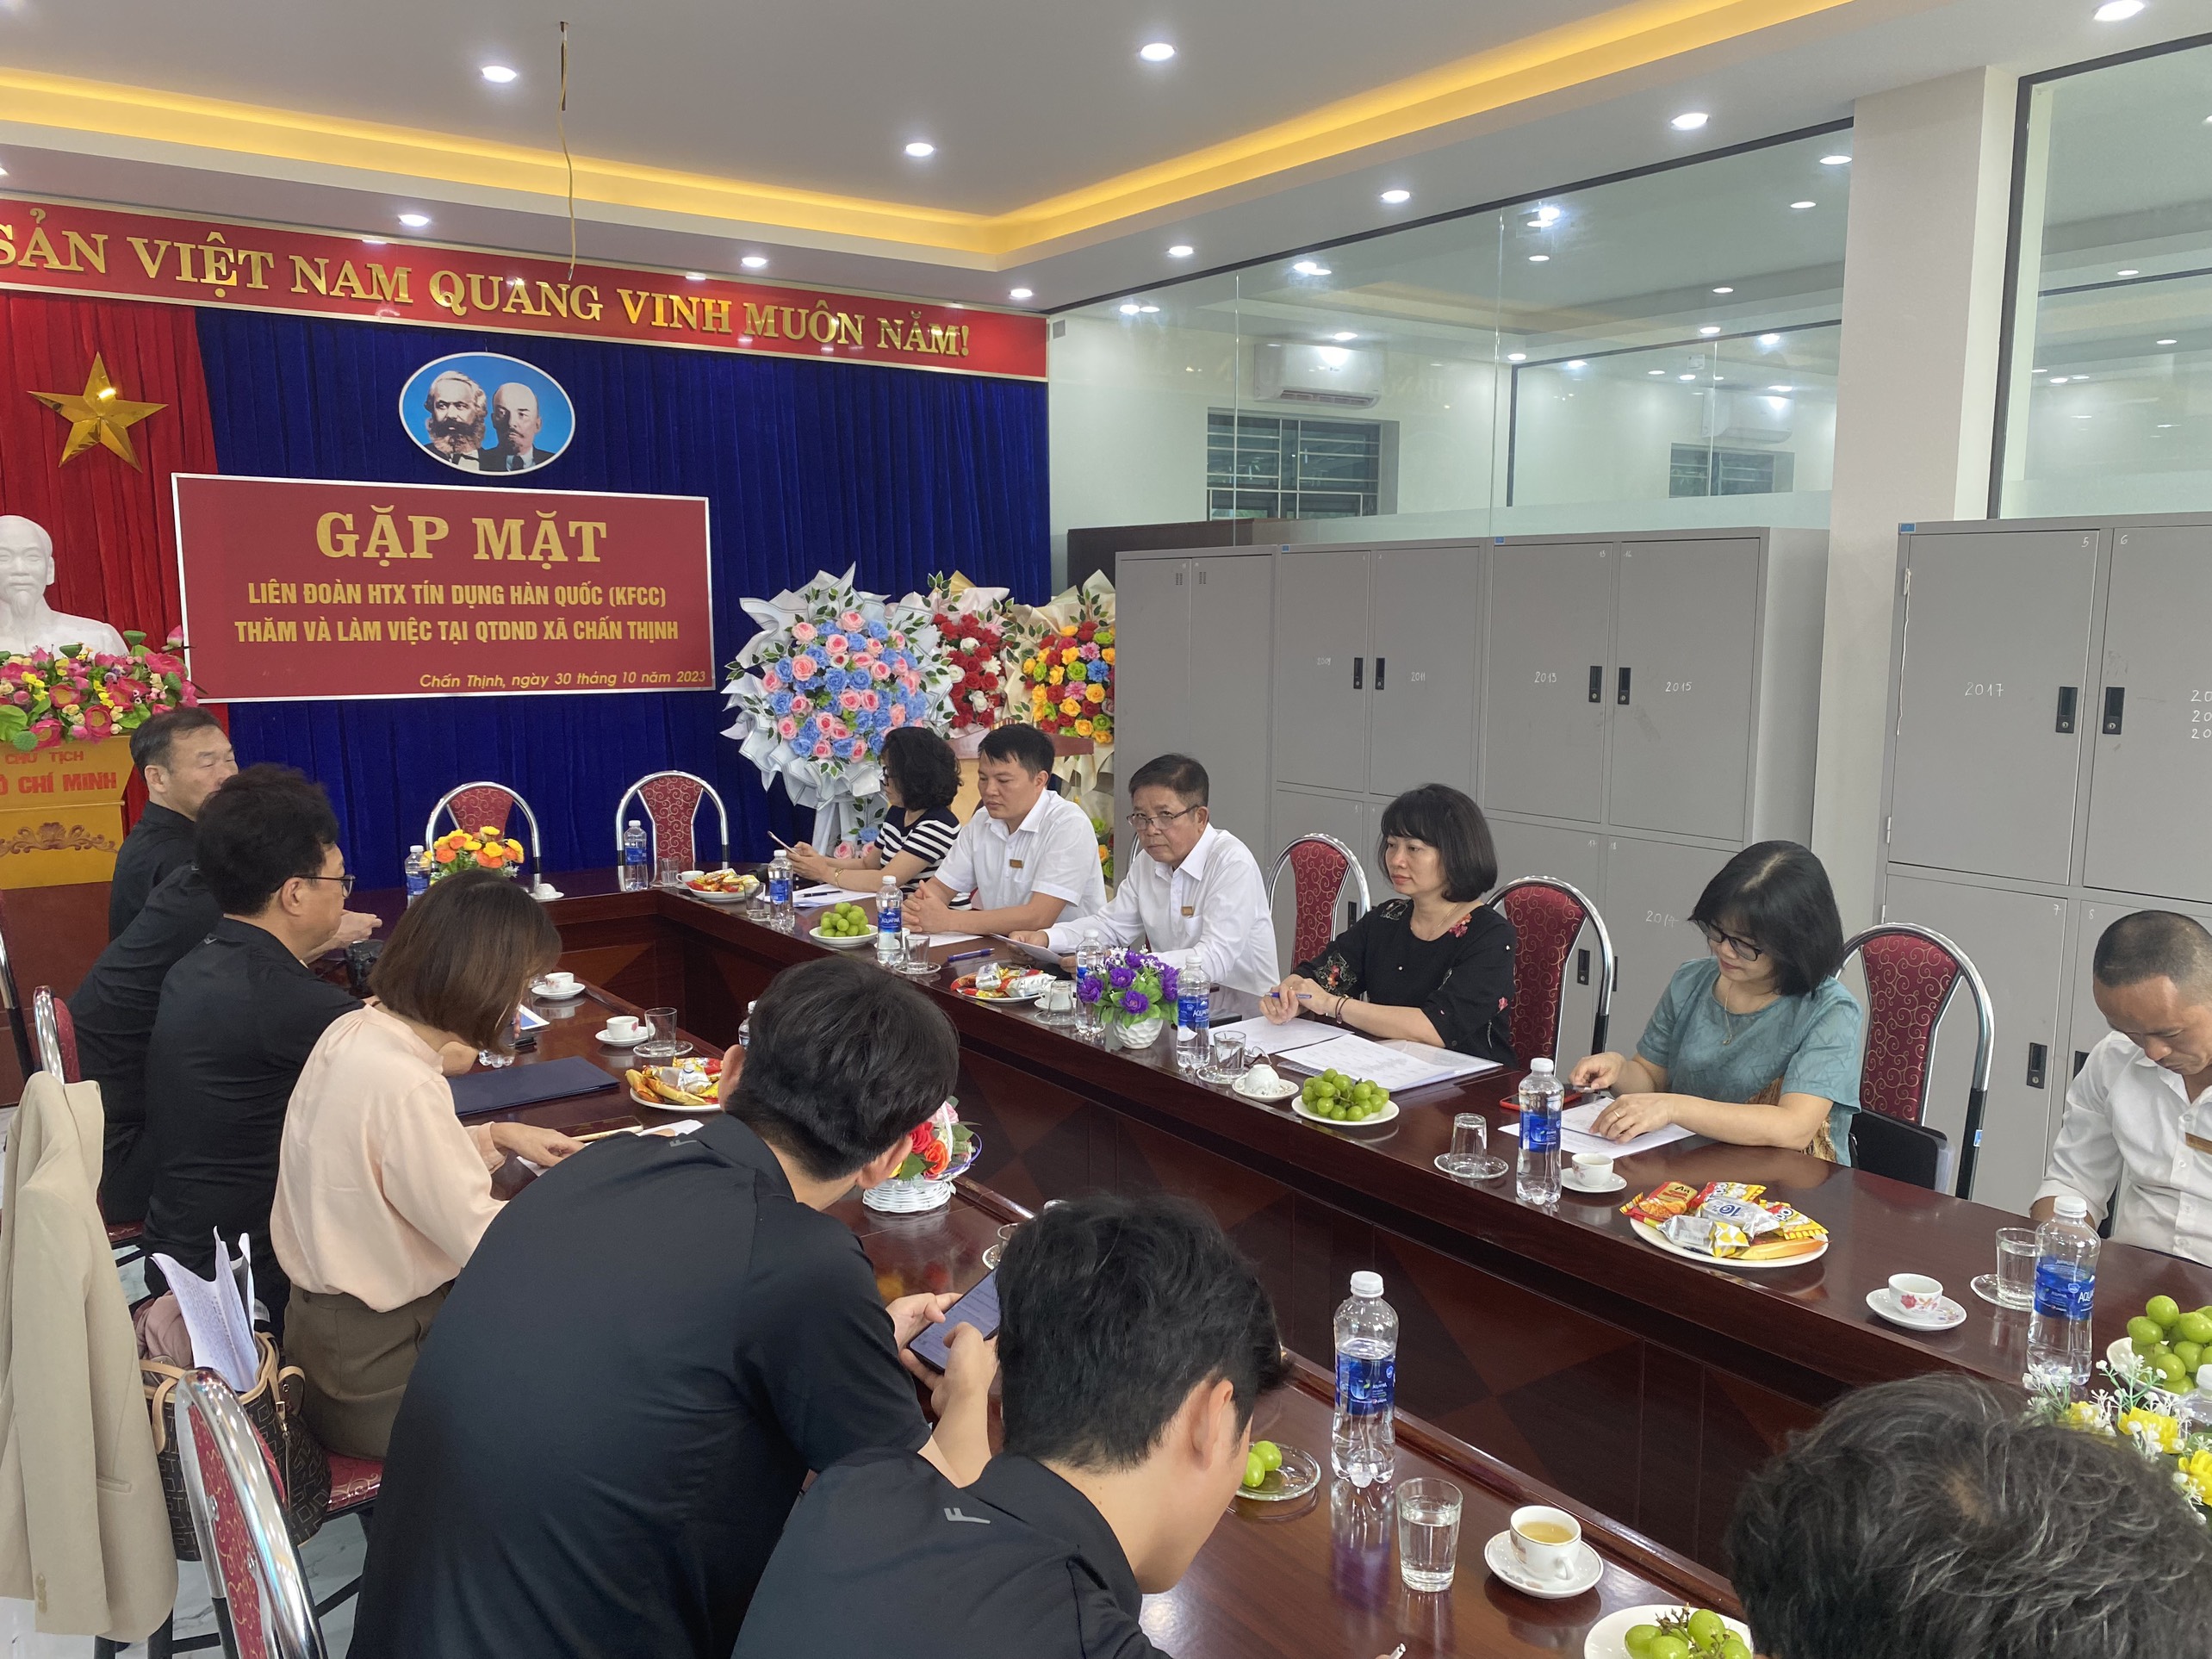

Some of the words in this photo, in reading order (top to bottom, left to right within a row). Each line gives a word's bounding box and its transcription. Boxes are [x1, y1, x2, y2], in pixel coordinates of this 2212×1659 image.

[0, 208, 109, 274] SẢN
[126, 231, 275, 298] VIỆT
[289, 255, 414, 304] NAM
[430, 269, 601, 321] QUANG
[617, 289, 732, 333] VINH
[743, 300, 864, 346] MUÔN
[877, 310, 970, 357] NĂM!
[316, 505, 450, 567] GẶP
[472, 510, 607, 570] MẶT
[2081, 537, 2090, 548] 5
[2120, 534, 2128, 545] 6
[248, 579, 297, 604] LIÊN
[303, 579, 362, 605] ĐOÀN
[368, 584, 407, 605] HTX
[412, 580, 444, 605] TÍN
[451, 585, 505, 609] DỤNG
[510, 581, 549, 605] HÀN
[555, 581, 603, 606] QUỐC
[609, 587, 666, 607] (KFCC)
[234, 617, 297, 643] THĂM
[303, 616, 332, 642] VÀ
[337, 617, 382, 642] LÀM
[388, 617, 432, 646] VIỆC
[438, 620, 469, 645] TẠI
[475, 620, 537, 643] QTDND
[544, 617, 569, 640] XÃ
[573, 615, 623, 640] CHẤN
[627, 620, 679, 643] THỊNH
[419, 674, 461, 687] Chấn
[467, 674, 506, 689] Thịnh,
[512, 672, 549, 688] ngày
[555, 672, 571, 685] 30
[577, 671, 618, 687] tháng
[623, 671, 637, 683] 10
[642, 672, 671, 683] năm
[676, 671, 705, 682] 2023
[1411, 671, 1426, 682] 2011
[1665, 681, 1693, 693] 2015
[1964, 681, 2005, 698] 2017
[2190, 689, 2212, 702] 20
[2191, 709, 2212, 723] 20
[2190, 728, 2212, 740] 20
[49, 750, 84, 765] TỊCH
[18, 771, 53, 794] CHÍ
[63, 772, 117, 792] MINH
[2054, 904, 2062, 916] 7
